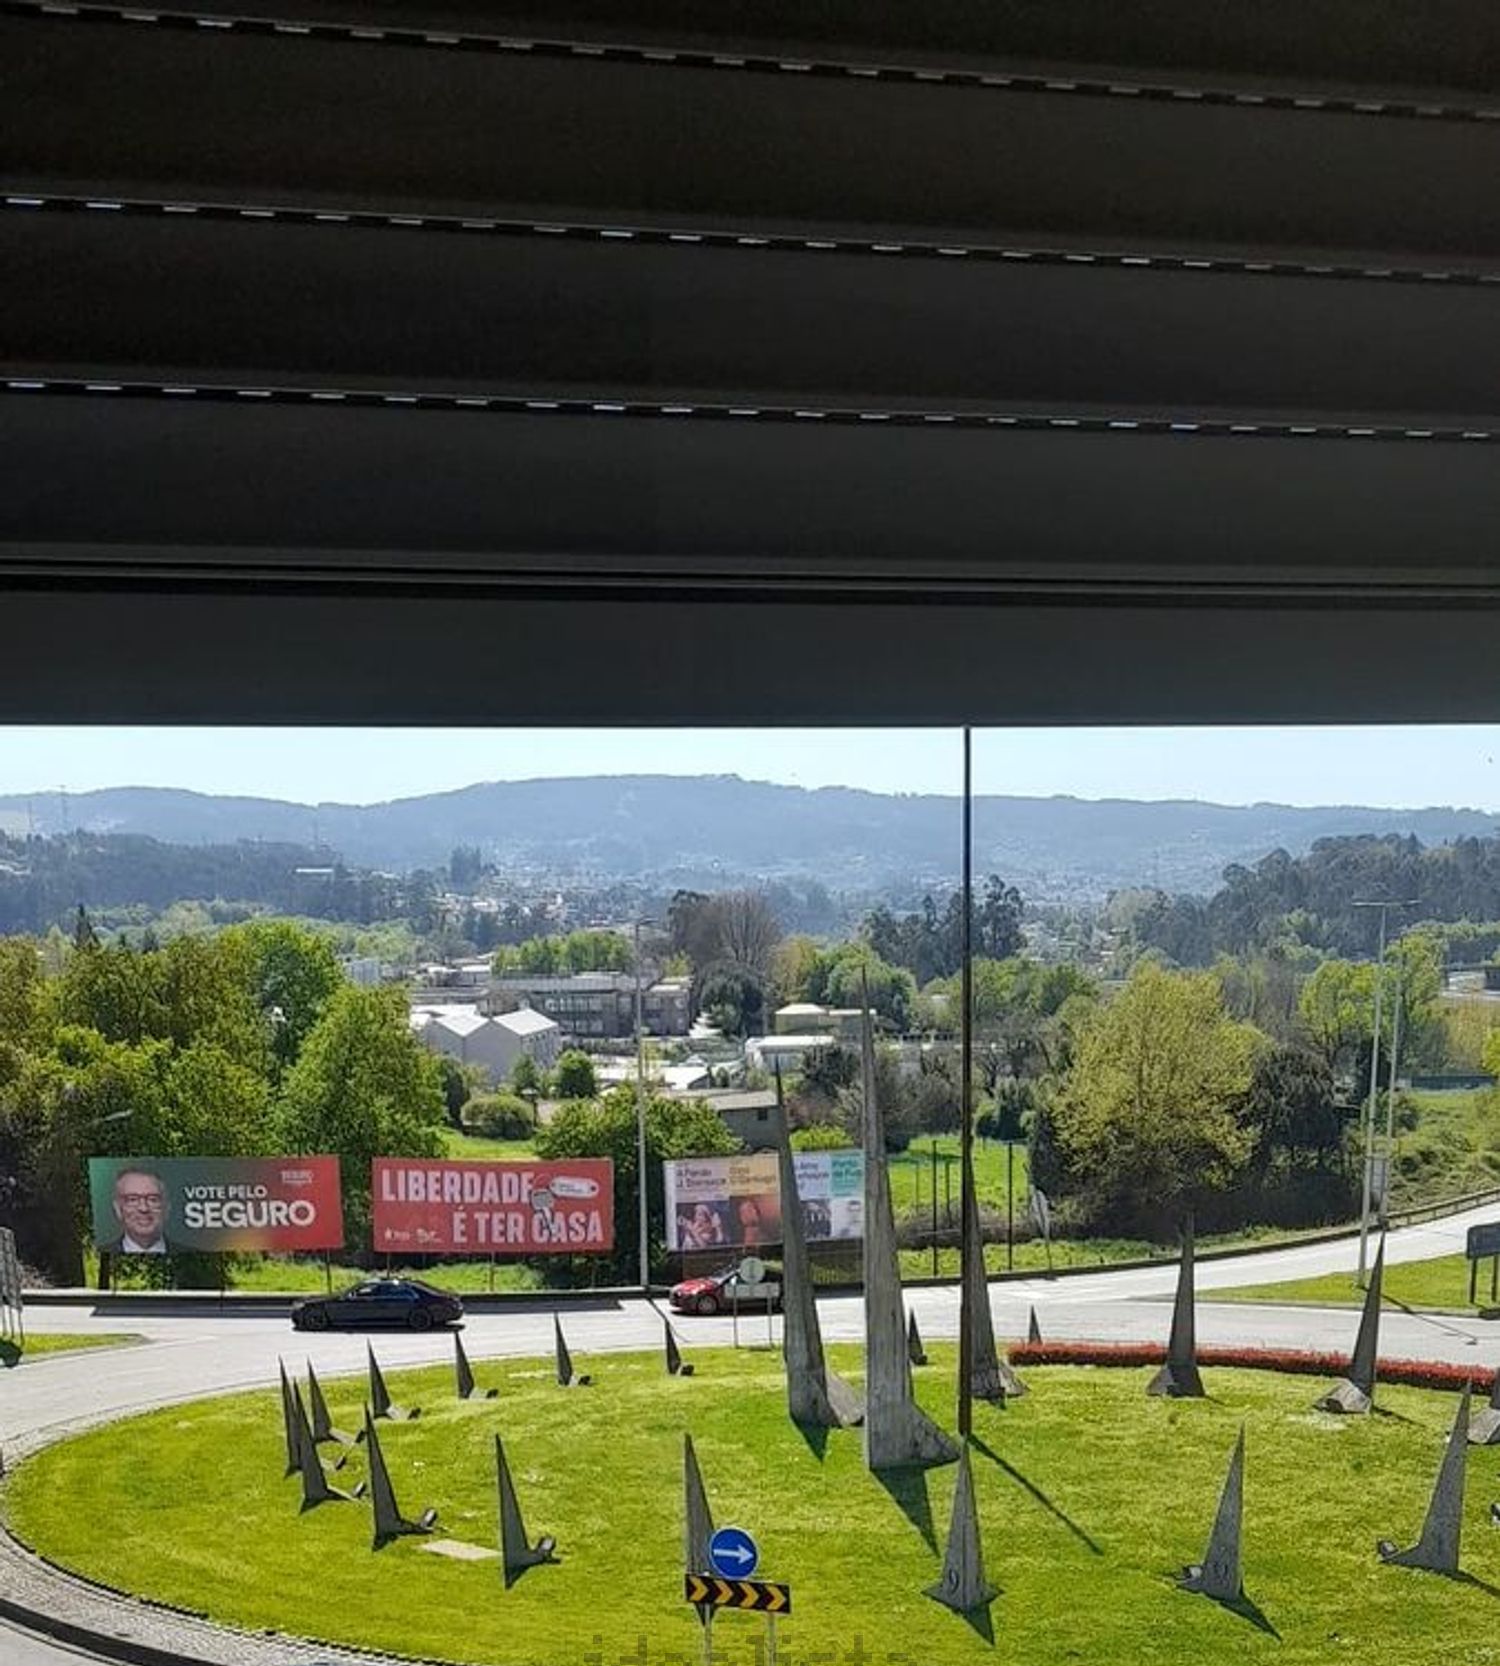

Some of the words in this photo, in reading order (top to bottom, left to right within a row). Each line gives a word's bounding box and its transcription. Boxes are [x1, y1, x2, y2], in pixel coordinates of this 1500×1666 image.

[184, 1186, 225, 1199] VOTE
[228, 1185, 268, 1199] PELO
[381, 1168, 536, 1203] LIBERDADE
[184, 1200, 316, 1228] SEGURO
[452, 1206, 467, 1243] É
[474, 1211, 525, 1243] TER
[531, 1211, 604, 1243] CASA
